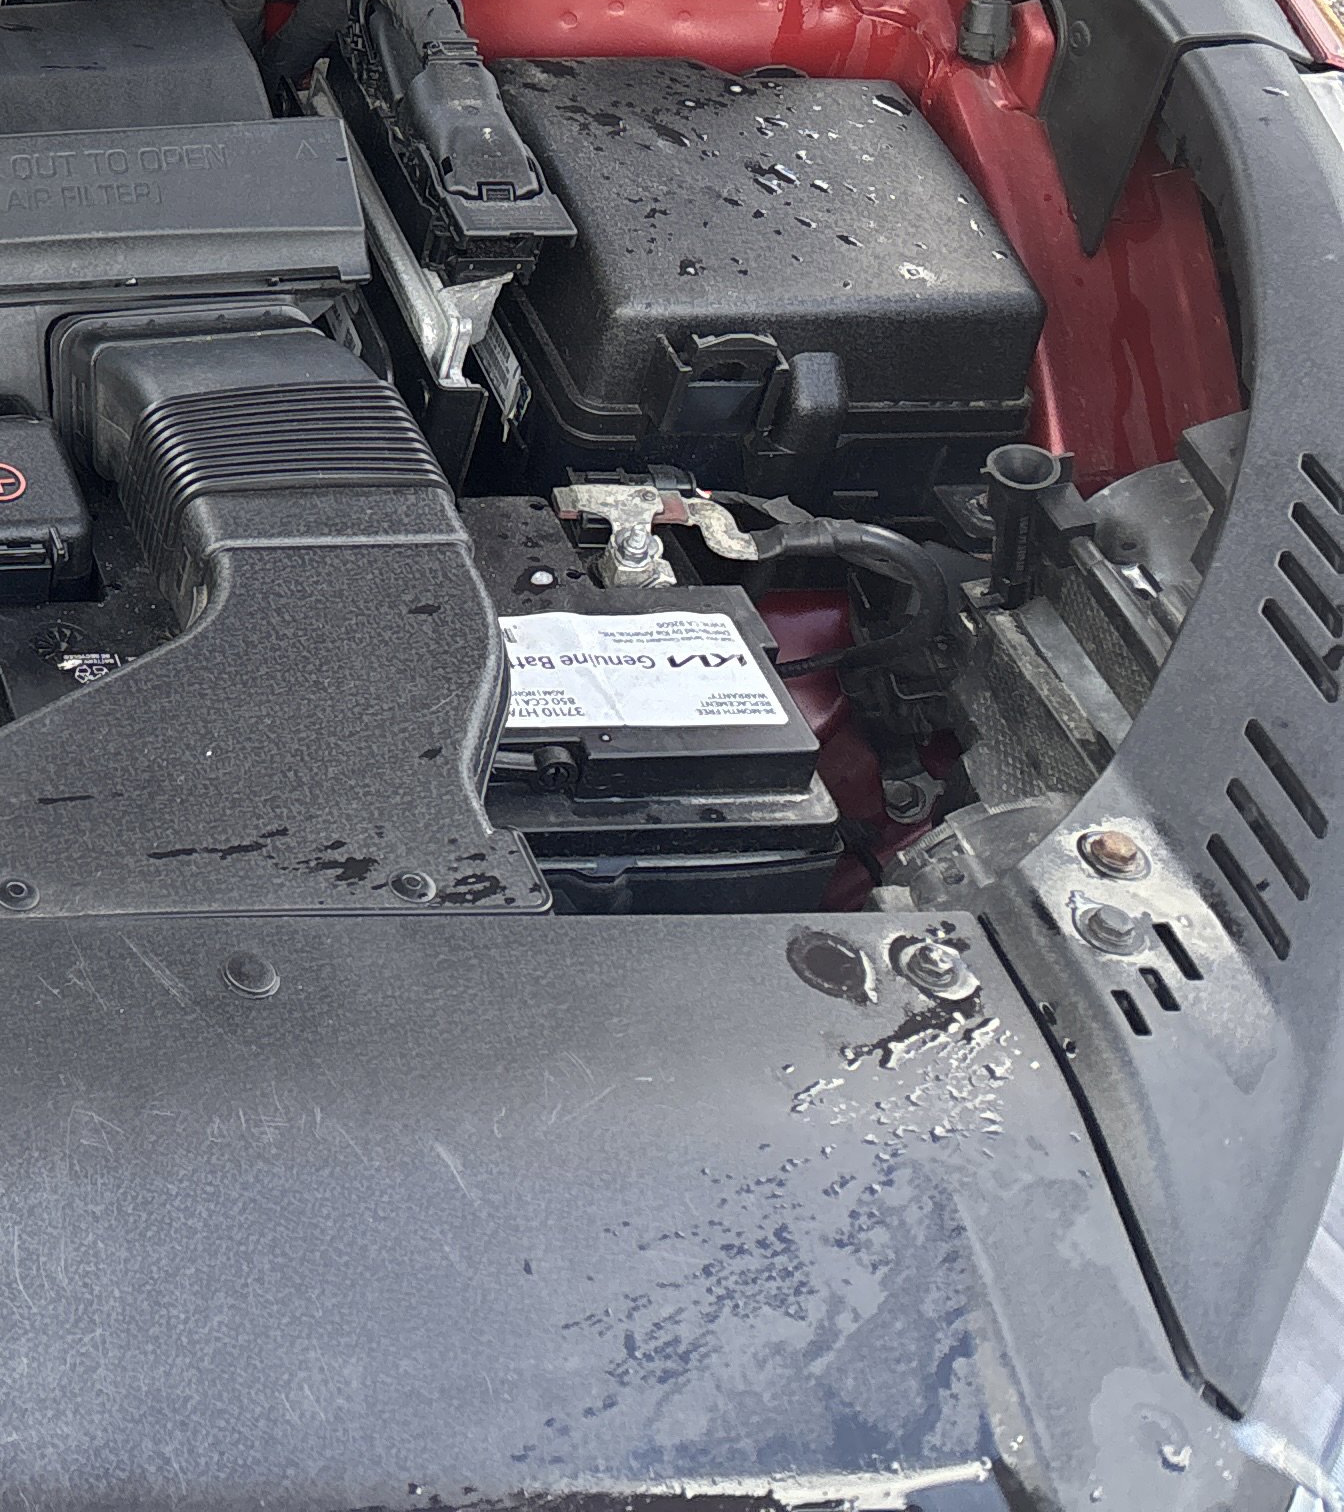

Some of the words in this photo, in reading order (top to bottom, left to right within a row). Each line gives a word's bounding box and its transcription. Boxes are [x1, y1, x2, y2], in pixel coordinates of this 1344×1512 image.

[11, 152, 76, 181] OUT
[84, 149, 127, 176] TO
[138, 144, 228, 173] OPEN
[559, 652, 656, 670] Genuine
[521, 697, 549, 707] CCA
[552, 698, 576, 706] 850
[699, 700, 772, 708] REPLACEMENT
[541, 706, 585, 718] 37110
[695, 708, 721, 716] FREE
